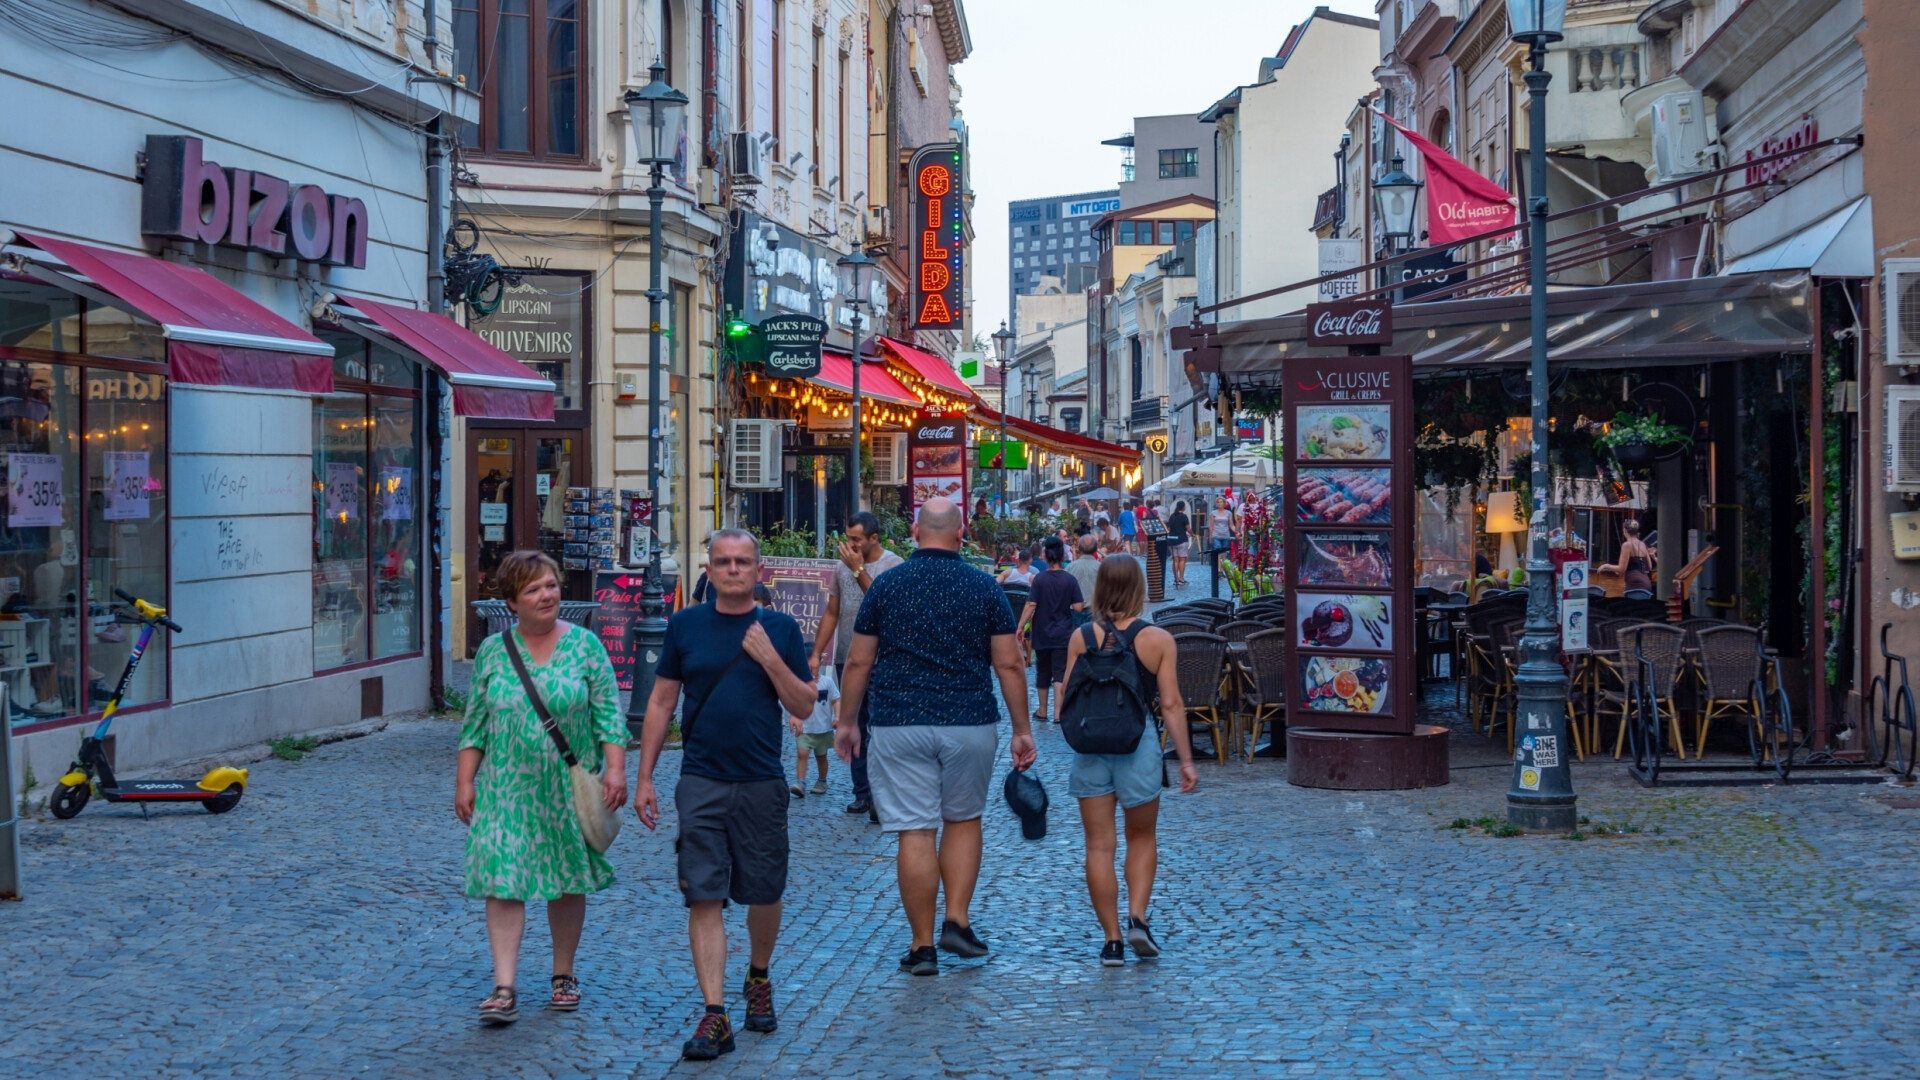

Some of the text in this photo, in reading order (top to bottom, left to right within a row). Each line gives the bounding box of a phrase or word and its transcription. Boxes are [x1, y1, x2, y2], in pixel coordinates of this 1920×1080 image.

[176, 134, 369, 270] bizon
[1070, 202, 1091, 215] NTT
[1438, 202, 1510, 221] Old HABITS
[919, 165, 951, 323] GILDA
[1320, 281, 1358, 295] COFFEE
[501, 299, 552, 315] LIPSCANI
[765, 320, 822, 333] JACK'S PUB
[479, 329, 573, 353] SOUVENIRS
[767, 333, 799, 342] LIPSCANI
[769, 351, 816, 371] Carlsberg
[1330, 390, 1350, 400] GRILL
[1357, 390, 1381, 400] CREPES
[28, 481, 61, 507] -35%
[774, 559, 793, 567] Little
[793, 559, 810, 567] Paris
[629, 577, 634, 586] 8
[773, 589, 819, 601] Muzeul
[1535, 737, 1555, 751] BNE
[1535, 751, 1556, 759] WAS
[1536, 758, 1557, 766] HERE
